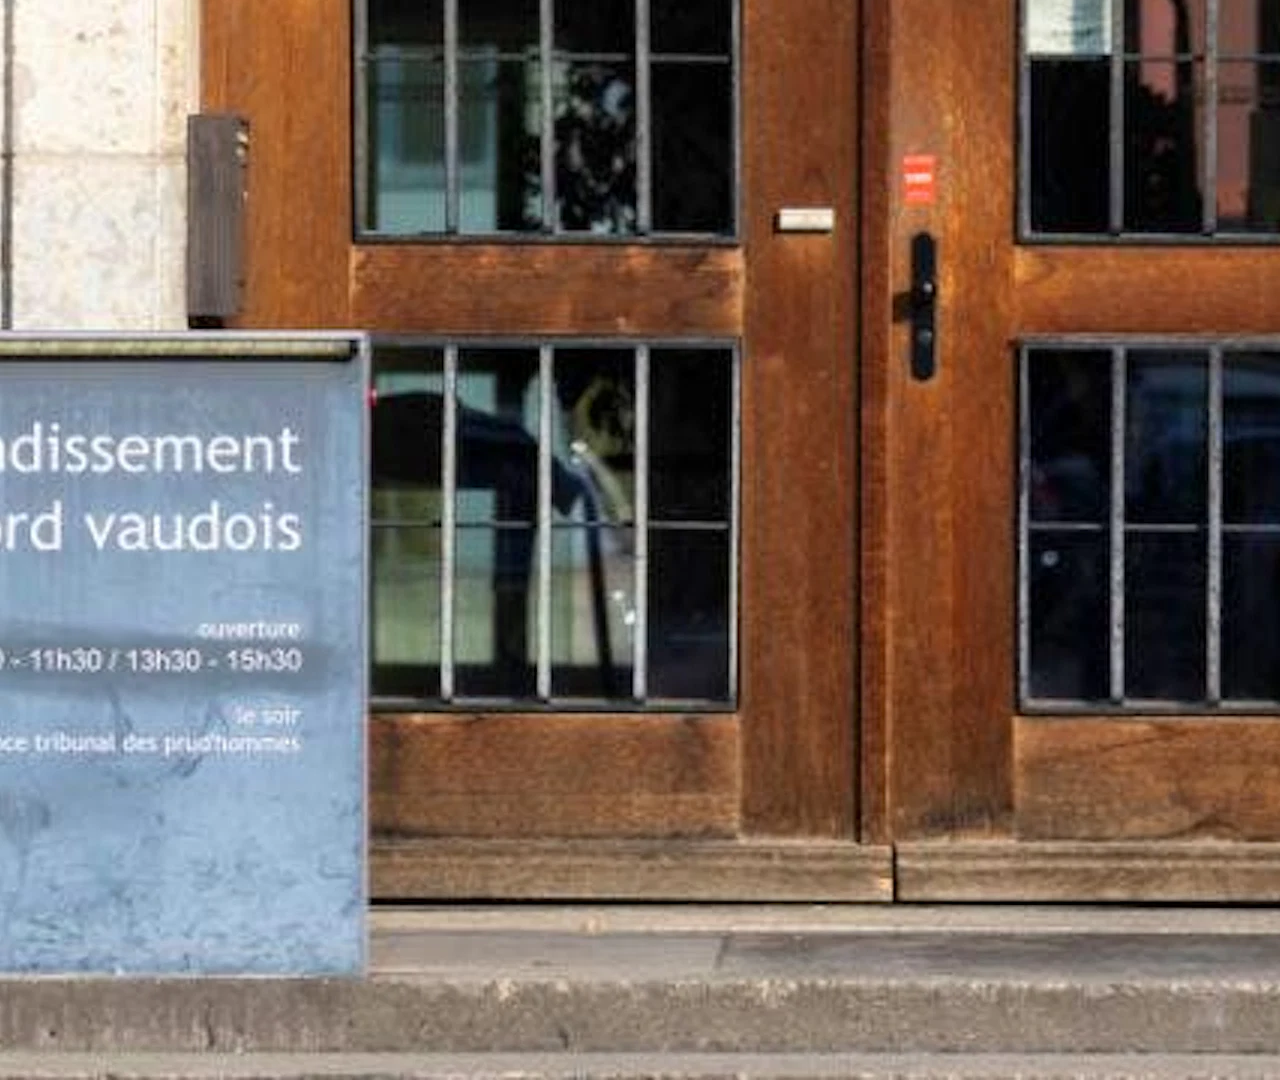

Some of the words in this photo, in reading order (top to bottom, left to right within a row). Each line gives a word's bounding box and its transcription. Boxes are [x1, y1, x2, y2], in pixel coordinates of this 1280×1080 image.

[84, 499, 302, 551] vaudois
[197, 621, 302, 640] ouverture
[30, 647, 102, 672] 11h30
[126, 647, 202, 671] 13h30
[227, 647, 303, 671] 15h30
[261, 706, 302, 726] soir
[34, 731, 116, 754] tribunal
[122, 732, 157, 753] des
